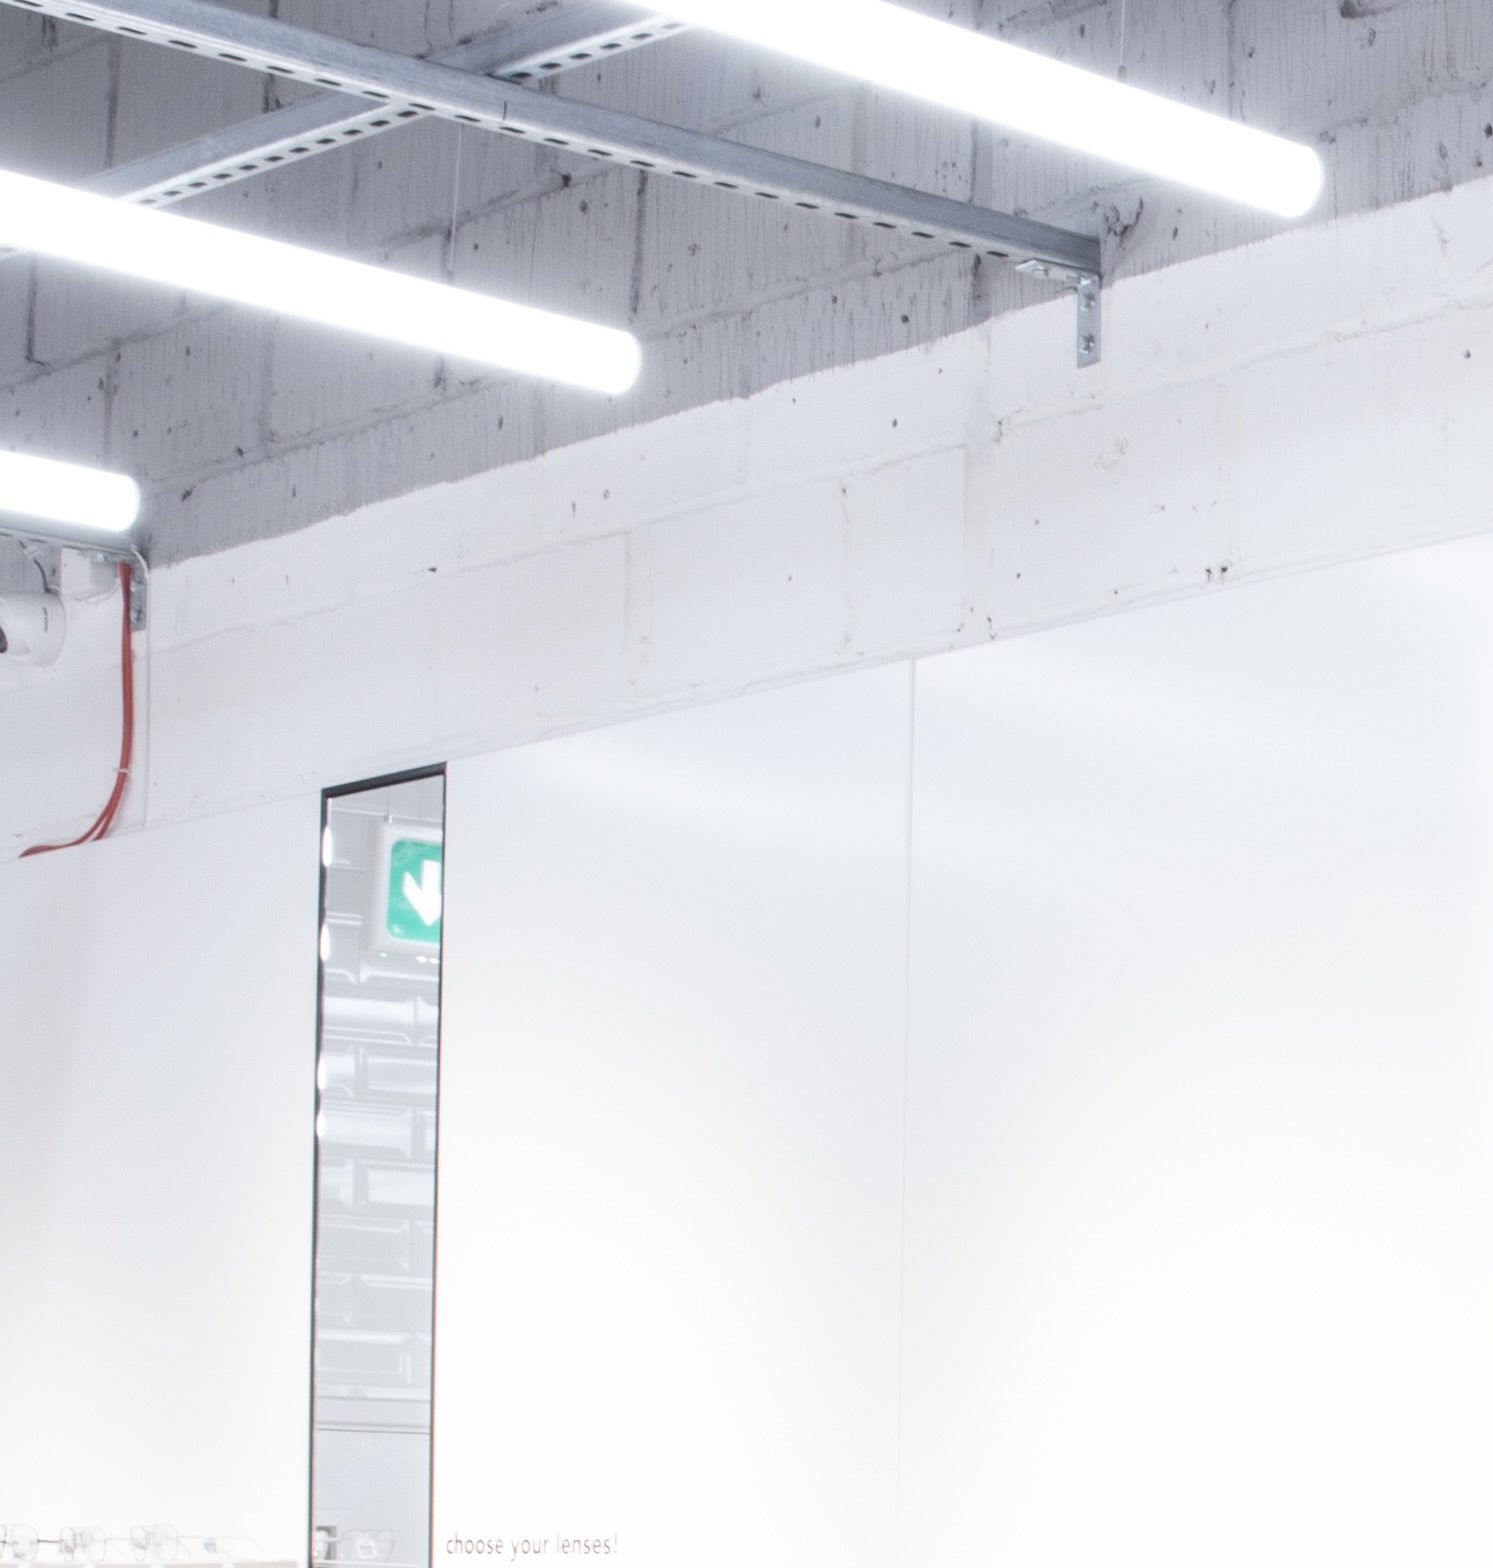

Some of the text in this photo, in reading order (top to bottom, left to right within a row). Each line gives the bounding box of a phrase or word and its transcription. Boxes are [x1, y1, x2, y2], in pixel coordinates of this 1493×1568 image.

[445, 1531, 618, 1562] choose your lenses!
